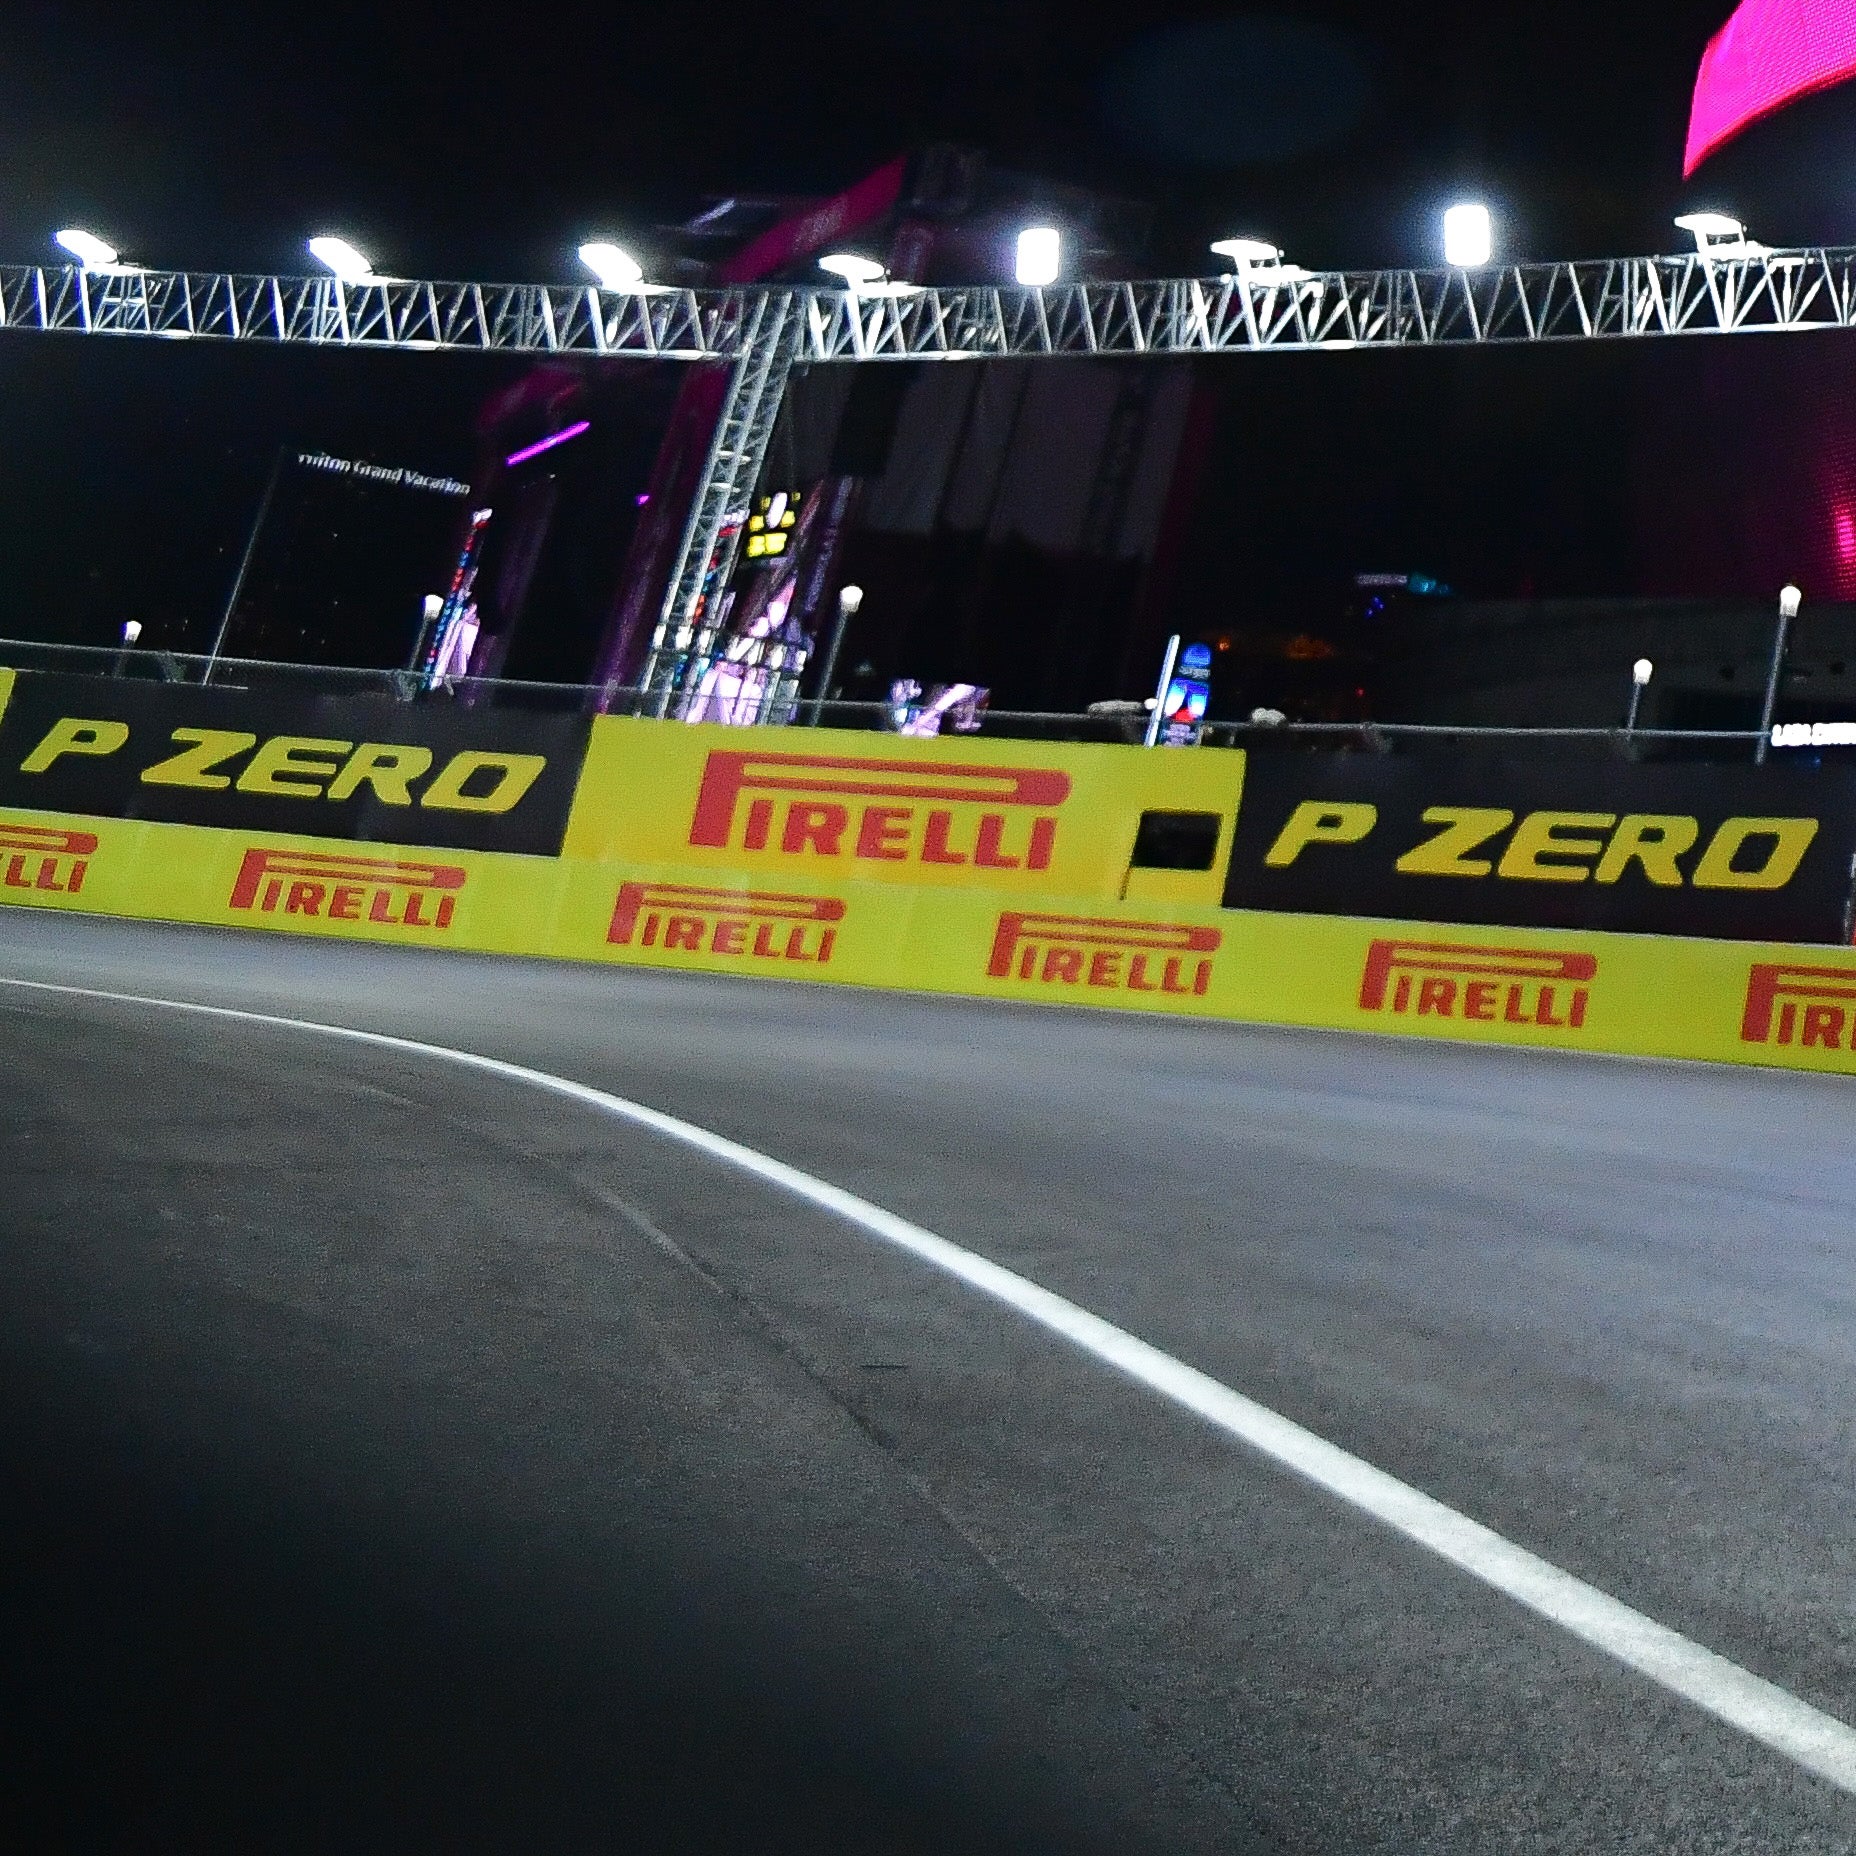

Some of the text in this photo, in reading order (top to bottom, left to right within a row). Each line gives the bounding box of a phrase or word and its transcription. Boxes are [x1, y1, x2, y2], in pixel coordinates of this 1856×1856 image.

[20, 717, 548, 814] P ZERO
[689, 750, 1071, 871] PIRELLI
[1264, 800, 1820, 891] P ZERO
[230, 849, 466, 929] PIRELLI
[606, 882, 846, 962] PIRELLI
[987, 912, 1222, 996] PIRELLI
[1359, 940, 1597, 1028] PIRELLI
